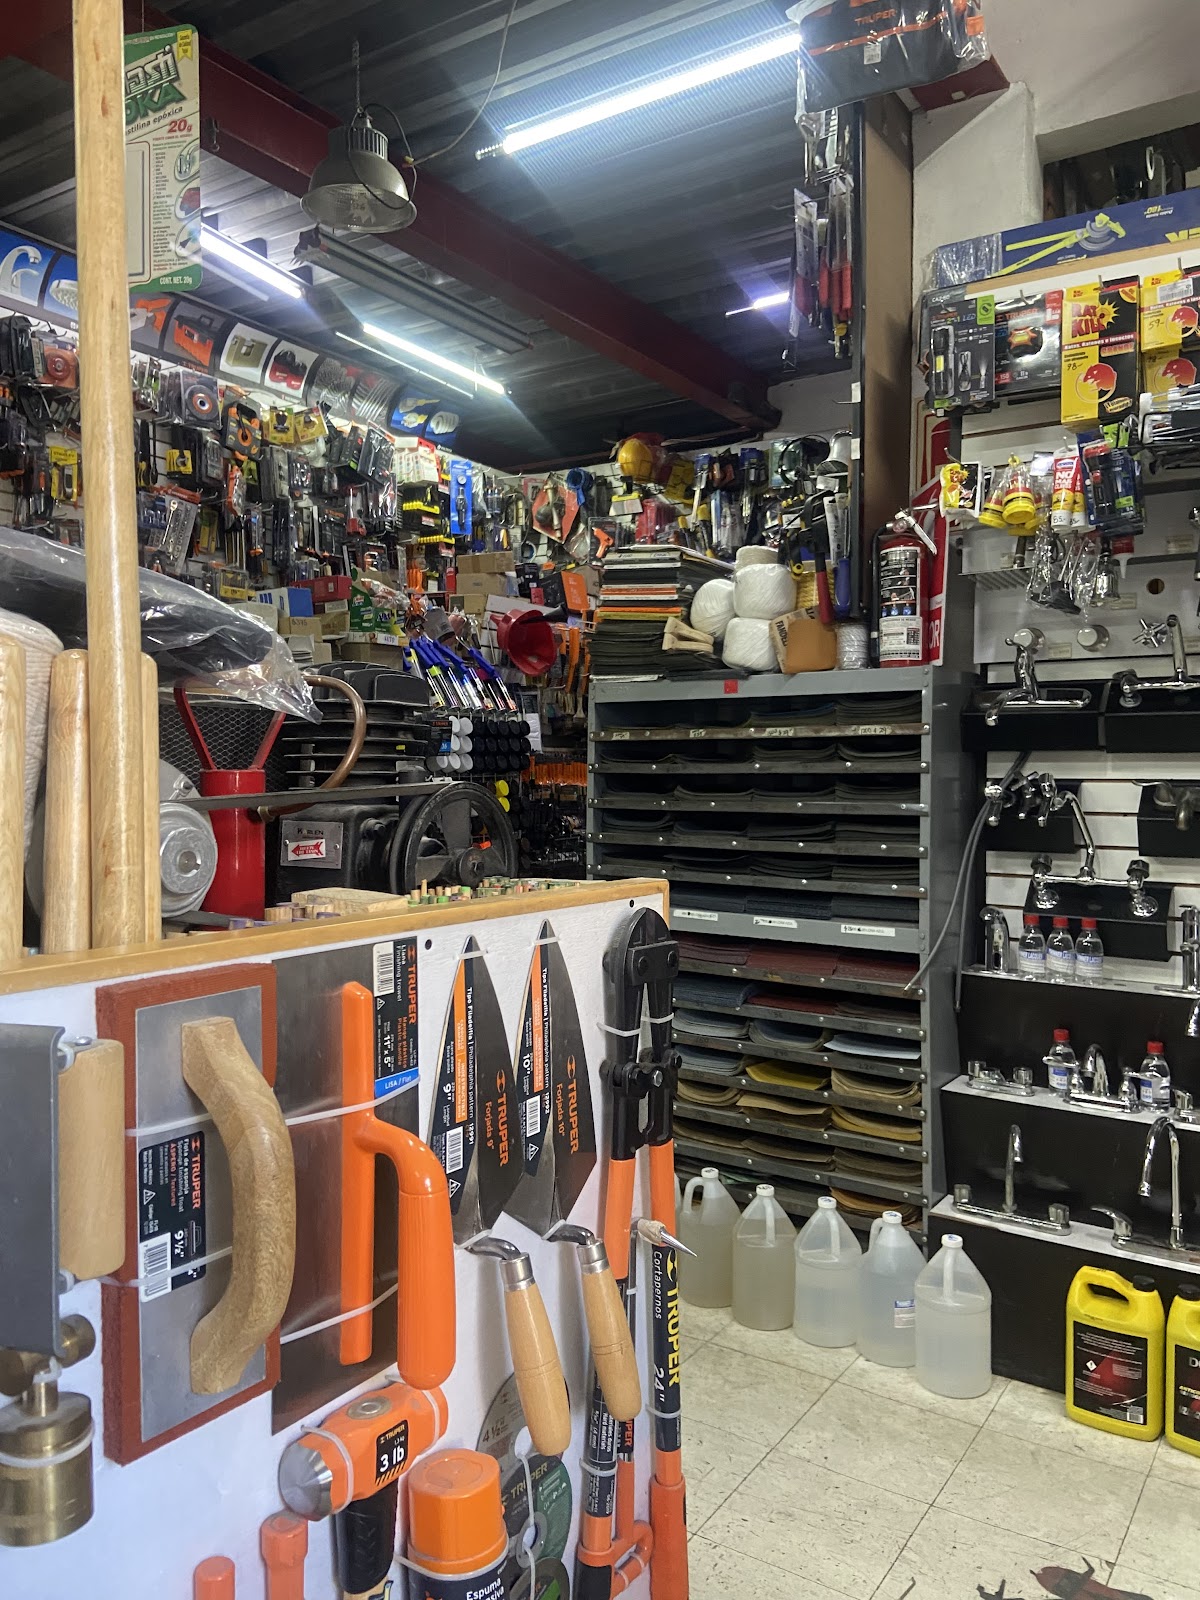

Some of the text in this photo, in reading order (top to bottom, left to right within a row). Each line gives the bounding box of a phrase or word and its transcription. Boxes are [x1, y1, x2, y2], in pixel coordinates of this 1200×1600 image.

[125, 82, 187, 125] OKA
[153, 106, 183, 124] epóxica
[1072, 303, 1097, 317] RAT
[1072, 317, 1106, 338] KILL
[408, 964, 417, 1025] TRUPER
[523, 1053, 531, 1074] 10"
[443, 1083, 452, 1101] 9"
[556, 1083, 564, 1120] Forjada
[484, 1101, 493, 1139] Forjada
[567, 1079, 579, 1154] TRUPER
[497, 1093, 510, 1167] TRUPER
[184, 1157, 189, 1166] de
[192, 1154, 201, 1209] TRUPER
[174, 1230, 184, 1240] 9
[653, 1251, 663, 1320] Cortapernos
[667, 1286, 681, 1388] TRUPER
[386, 1424, 405, 1440] TRUPER
[482, 1429, 489, 1442] 4
[380, 1445, 404, 1472] 3 lb
[466, 1578, 501, 1600] Espuma
